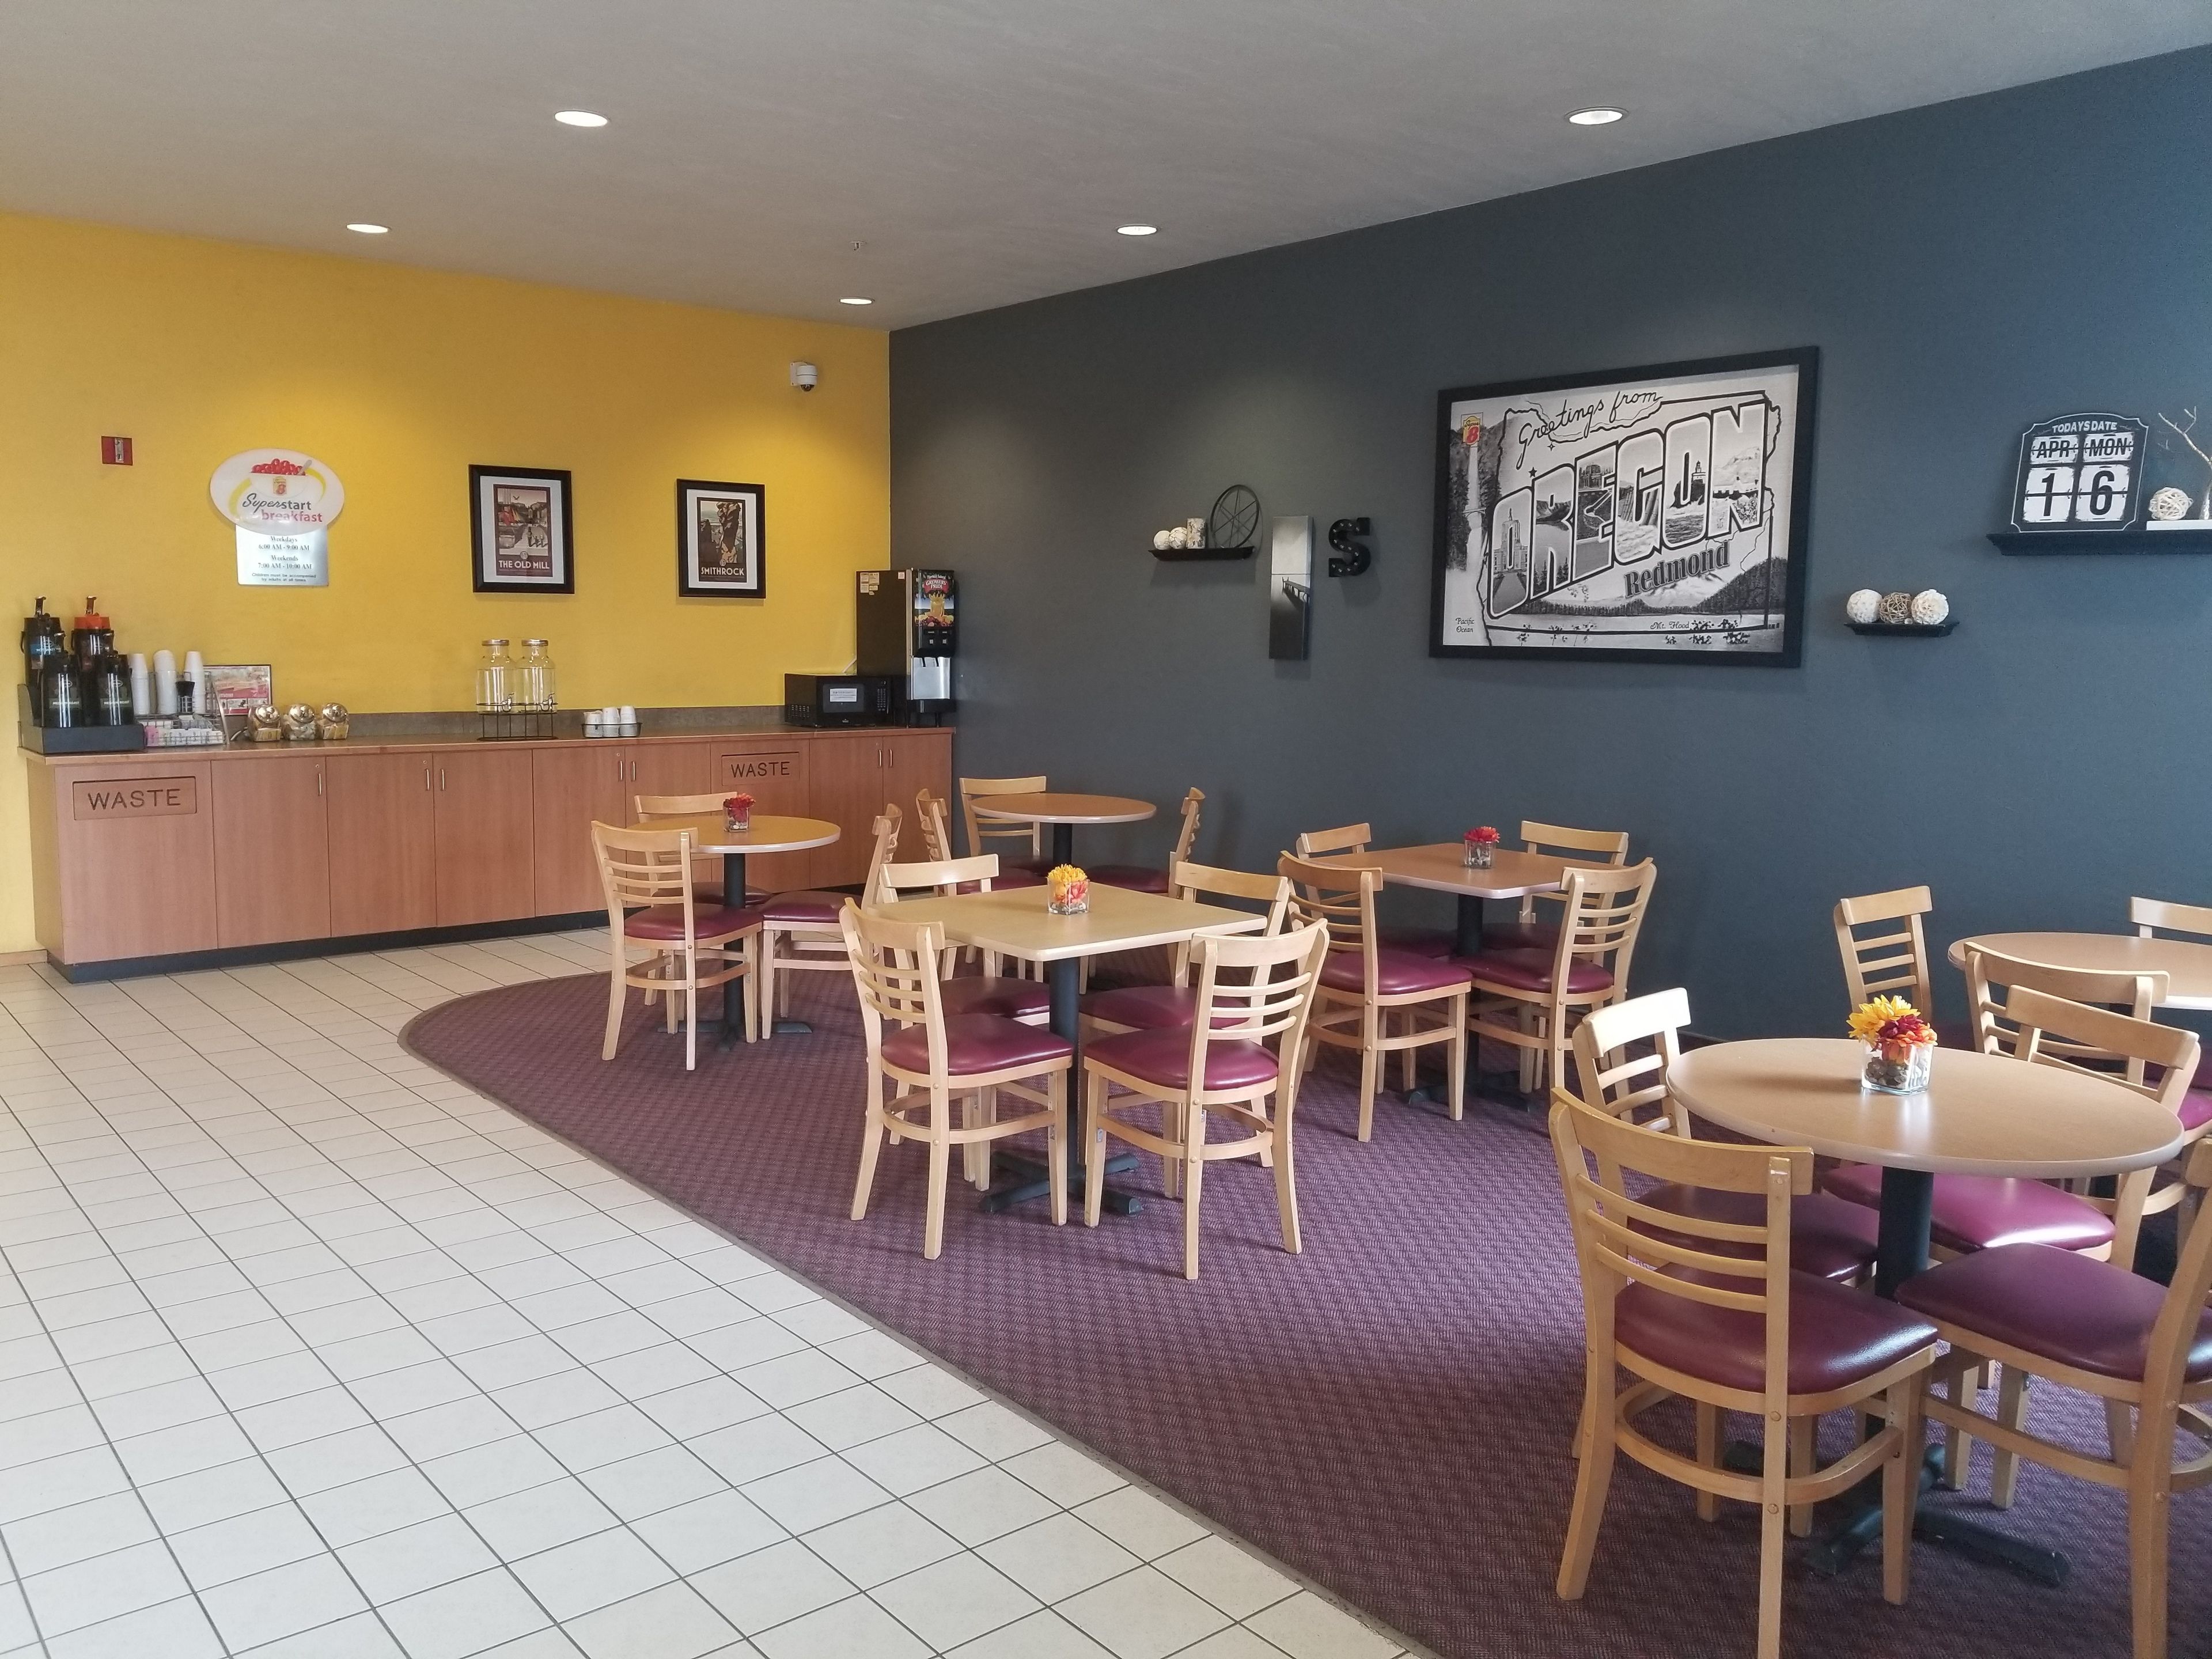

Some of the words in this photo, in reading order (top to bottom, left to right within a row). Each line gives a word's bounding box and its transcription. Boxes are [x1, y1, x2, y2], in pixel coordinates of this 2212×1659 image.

[1467, 426, 1479, 444] 8
[1516, 399, 1604, 470] Greetings
[1609, 391, 1663, 423] from
[2052, 421, 2090, 433] TODAYS
[2091, 421, 2118, 431] DATE
[2036, 440, 2070, 459] APR
[2089, 438, 2127, 457] MON
[262, 509, 323, 522] breakfast
[1487, 402, 1766, 620] OREGON
[498, 560, 513, 568] THE
[514, 560, 531, 569] OLD
[533, 561, 550, 569] MILL
[700, 567, 744, 575] SMITHROCK
[1624, 541, 1730, 598] Redmond
[1669, 621, 1690, 630] Hood
[731, 762, 790, 778] WASTE
[88, 789, 181, 810] WASTE
